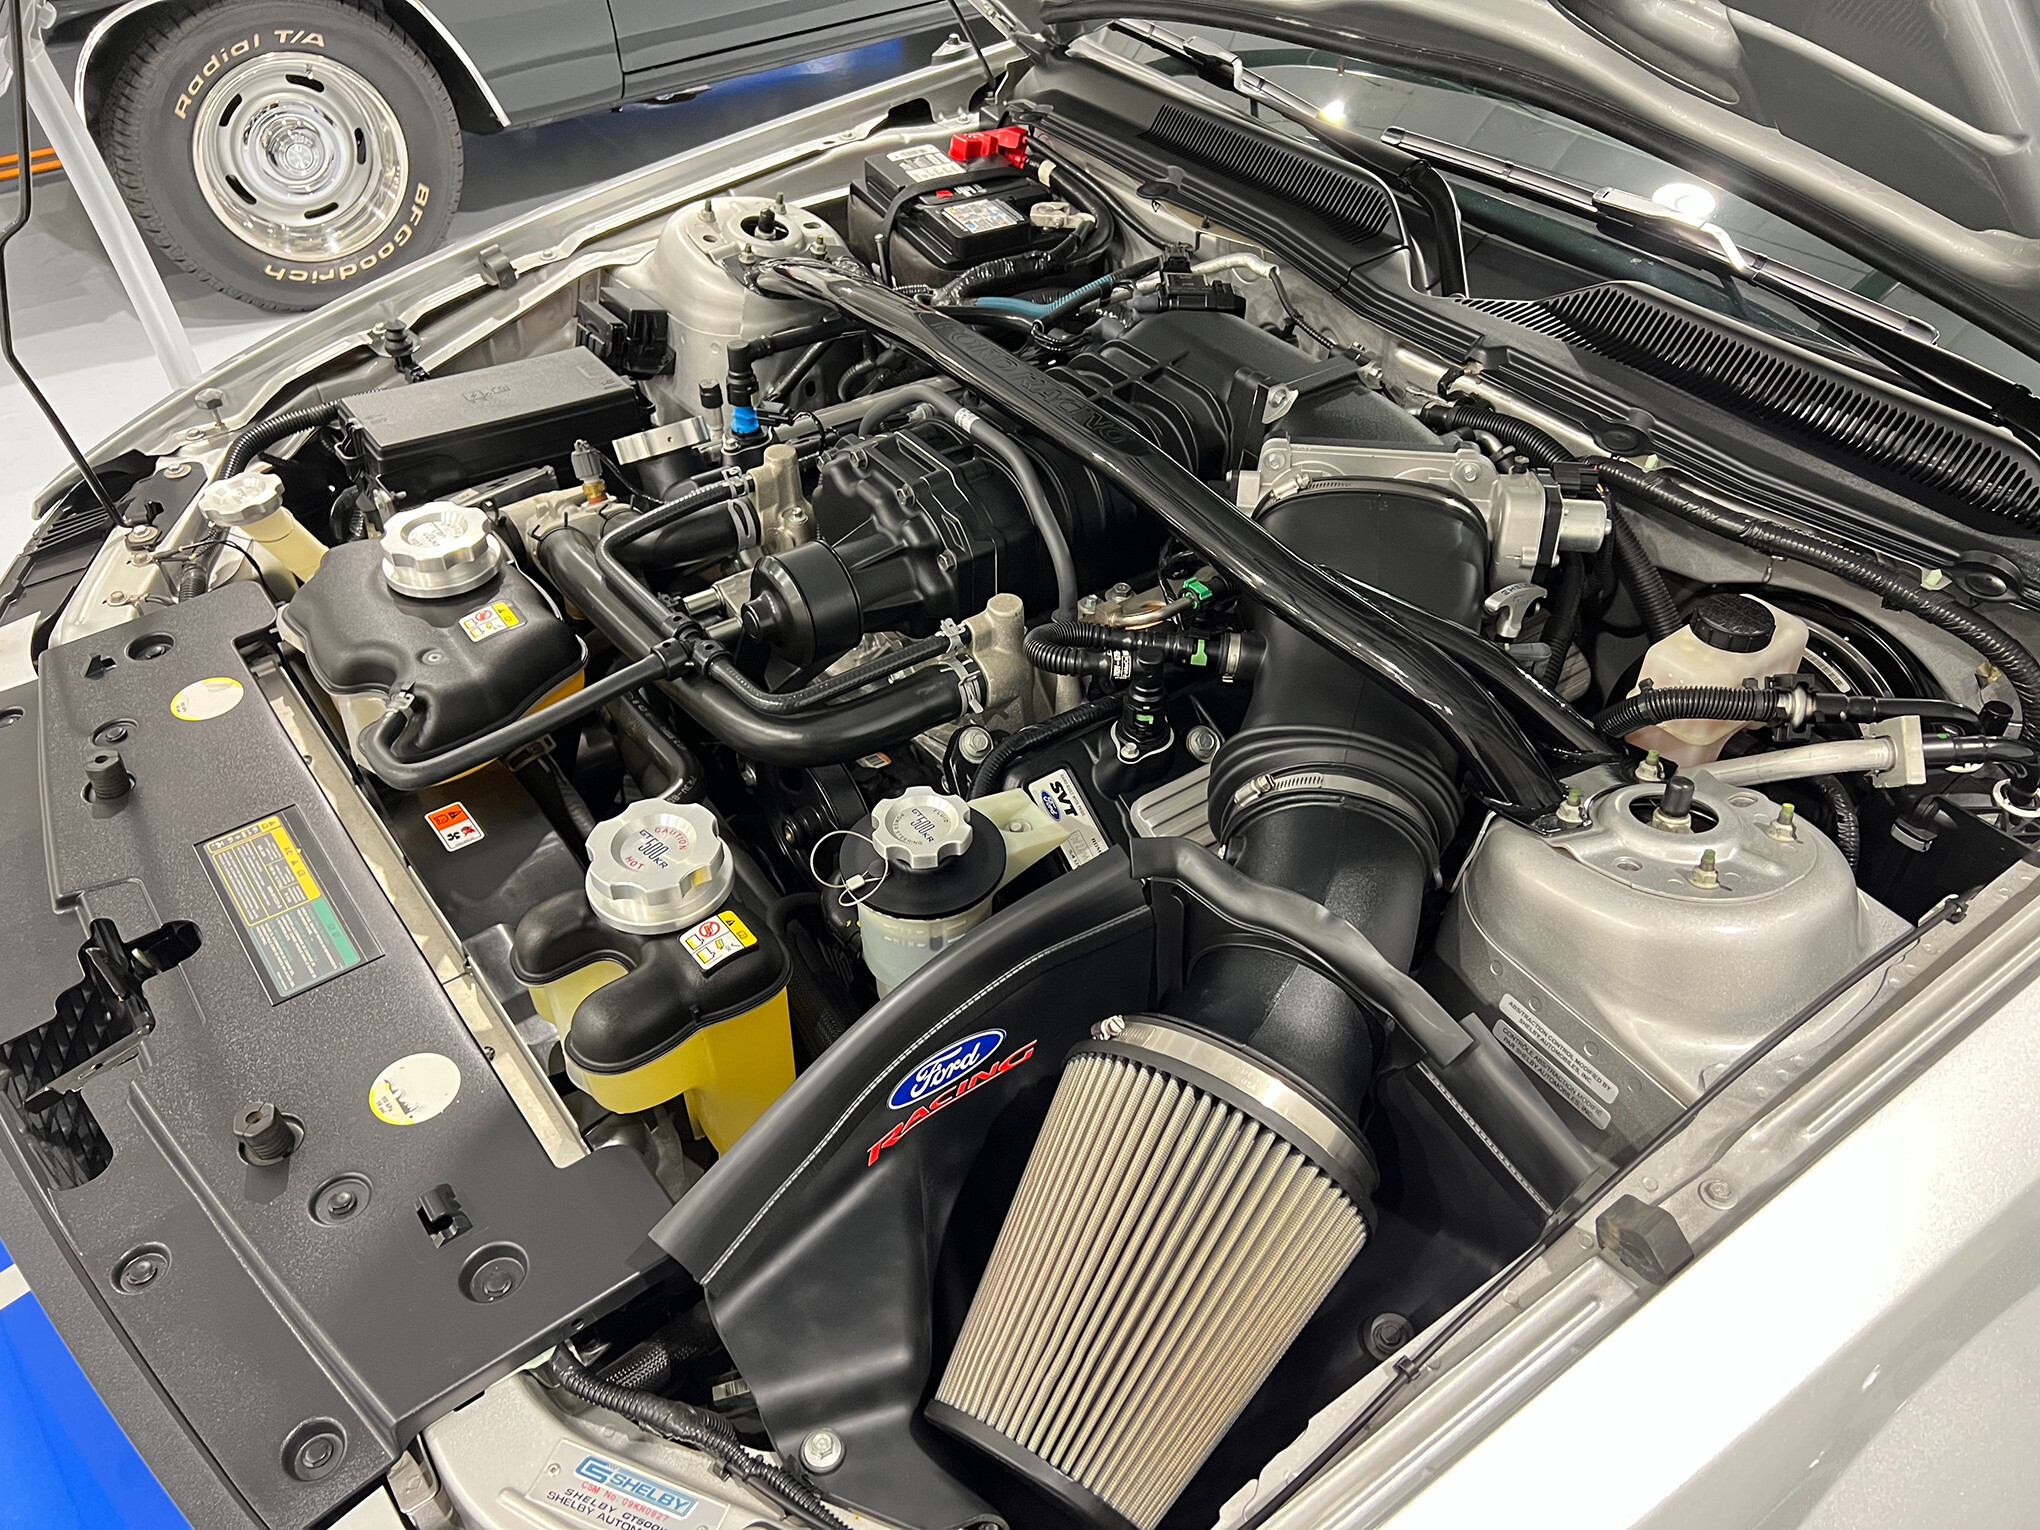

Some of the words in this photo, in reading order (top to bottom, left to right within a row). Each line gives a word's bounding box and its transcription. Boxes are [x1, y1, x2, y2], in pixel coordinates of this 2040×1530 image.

[174, 33, 259, 120] Radial
[274, 29, 325, 48] T/A
[264, 183, 430, 284] BFGoodrich
[1050, 781, 1078, 816] SVT
[638, 830, 668, 868] GT500KR
[654, 827, 687, 850] CAUTION
[625, 856, 644, 869] HOT
[1502, 1036, 1516, 1050] PAR
[1514, 1047, 1539, 1070] SHELBY
[1508, 1000, 1549, 1038] ABS/TRACTION
[1547, 1035, 1575, 1060] CONTROL
[1574, 1058, 1603, 1084] MODIFIED
[1518, 1018, 1541, 1039] SHELBY
[1580, 1072, 1593, 1085] INC.
[910, 1042, 981, 1098] Ford
[1502, 1027, 1535, 1058] CONTRÔLE
[1533, 1054, 1578, 1095] ABS/TRACTION
[867, 1039, 1037, 1167] RACING
[547, 1491, 594, 1515] SHELBY
[565, 1489, 617, 1513] SHELBY
[581, 1481, 600, 1494] CSM
[610, 1474, 689, 1510] SHELBY
